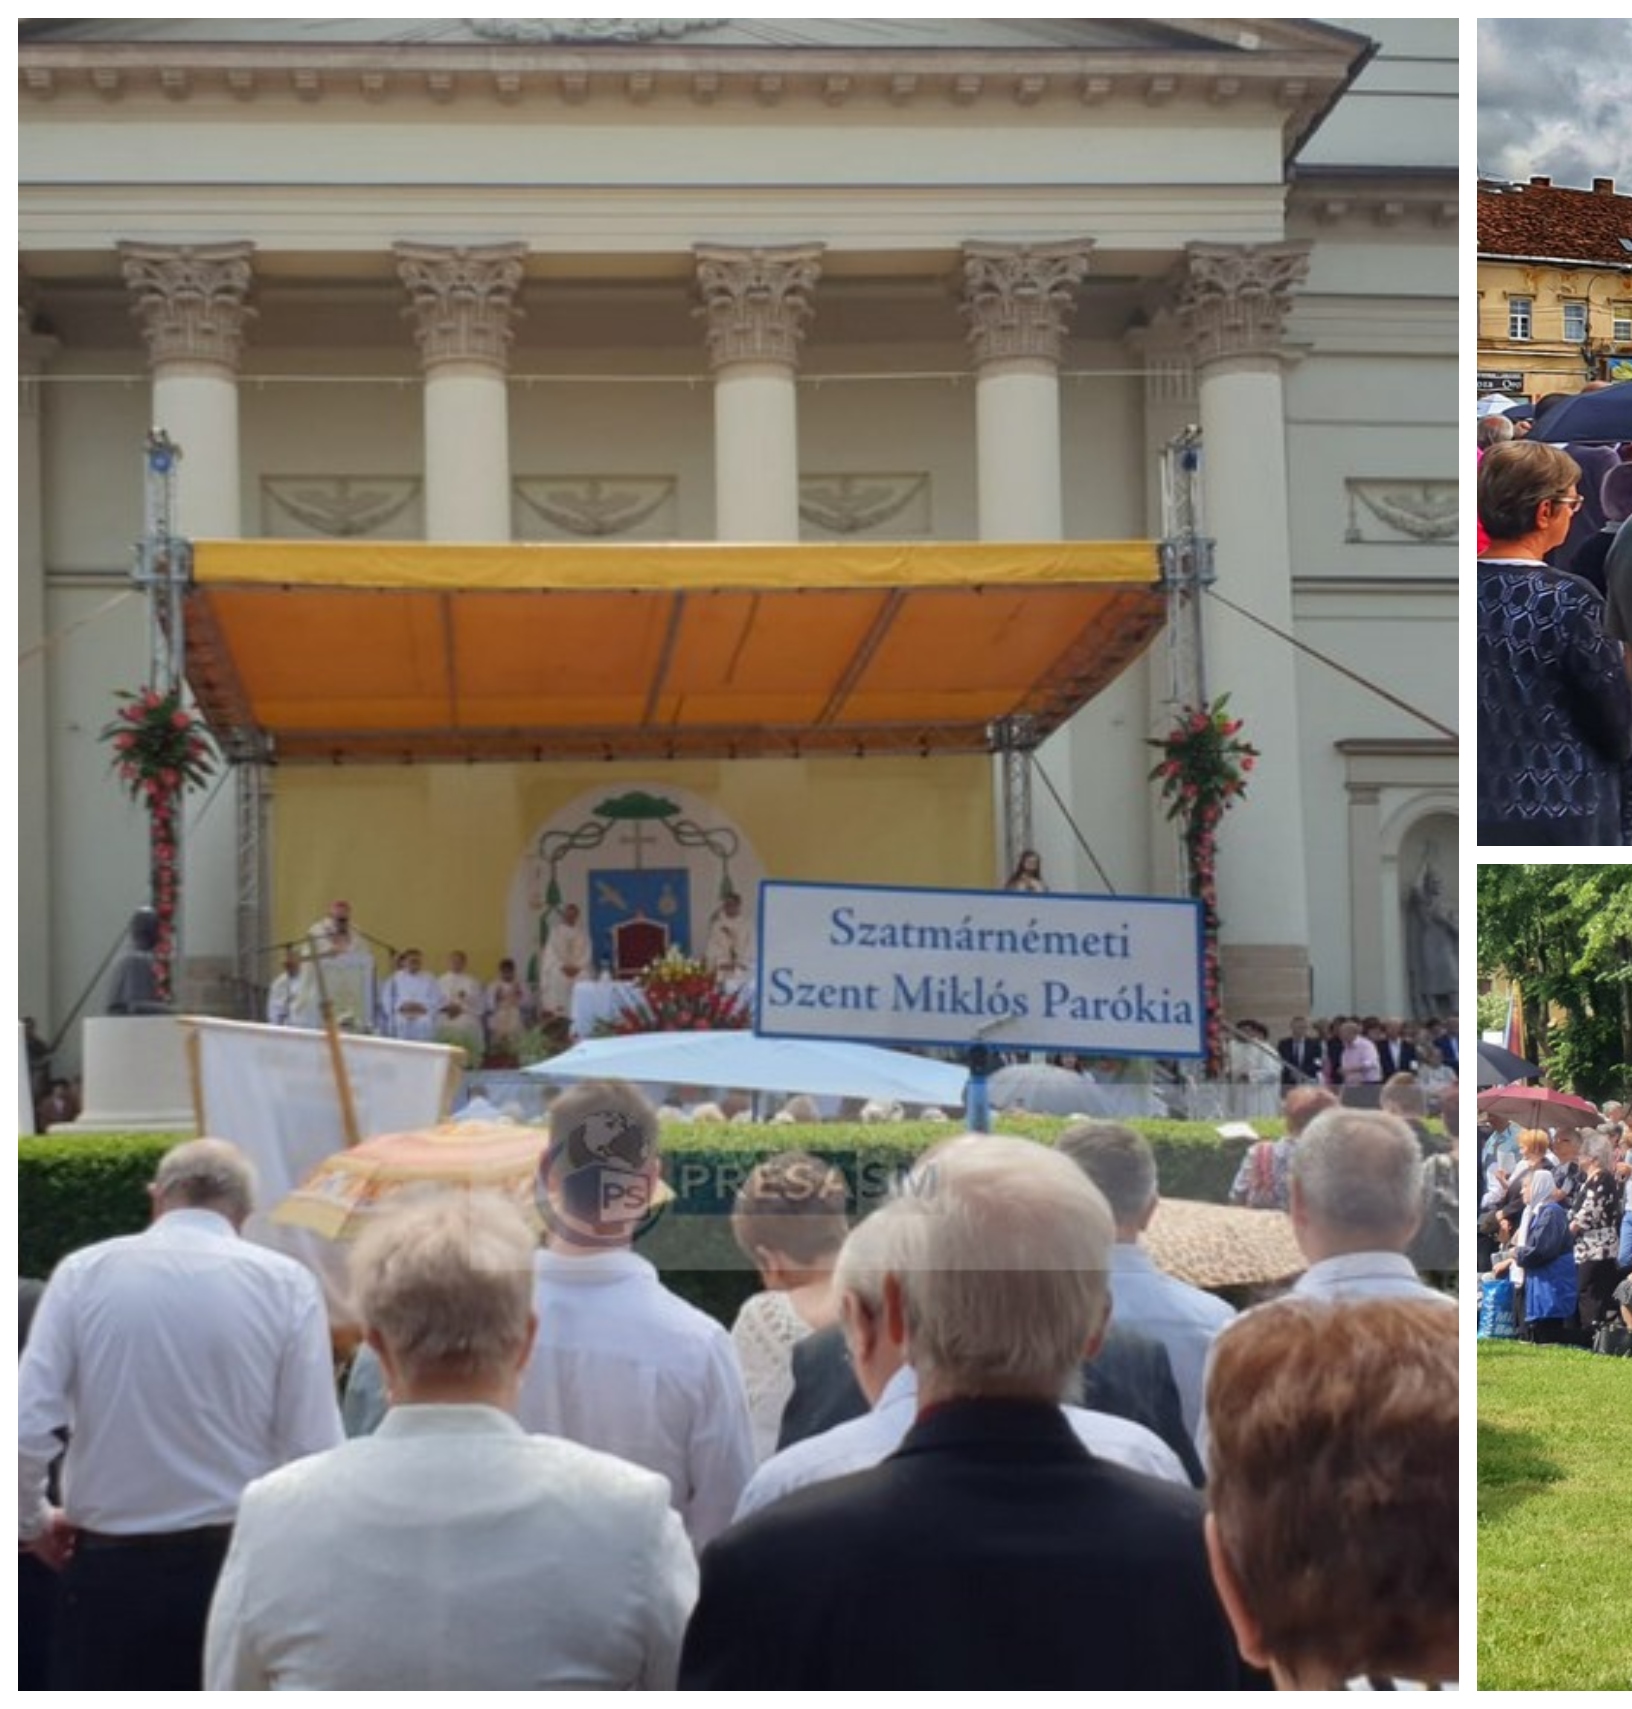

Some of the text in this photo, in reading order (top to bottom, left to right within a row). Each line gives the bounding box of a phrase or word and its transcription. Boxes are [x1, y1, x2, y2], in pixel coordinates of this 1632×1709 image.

[829, 906, 1132, 959] Szatmárnémeti
[769, 967, 1194, 1025] Szent Miklós Parókia
